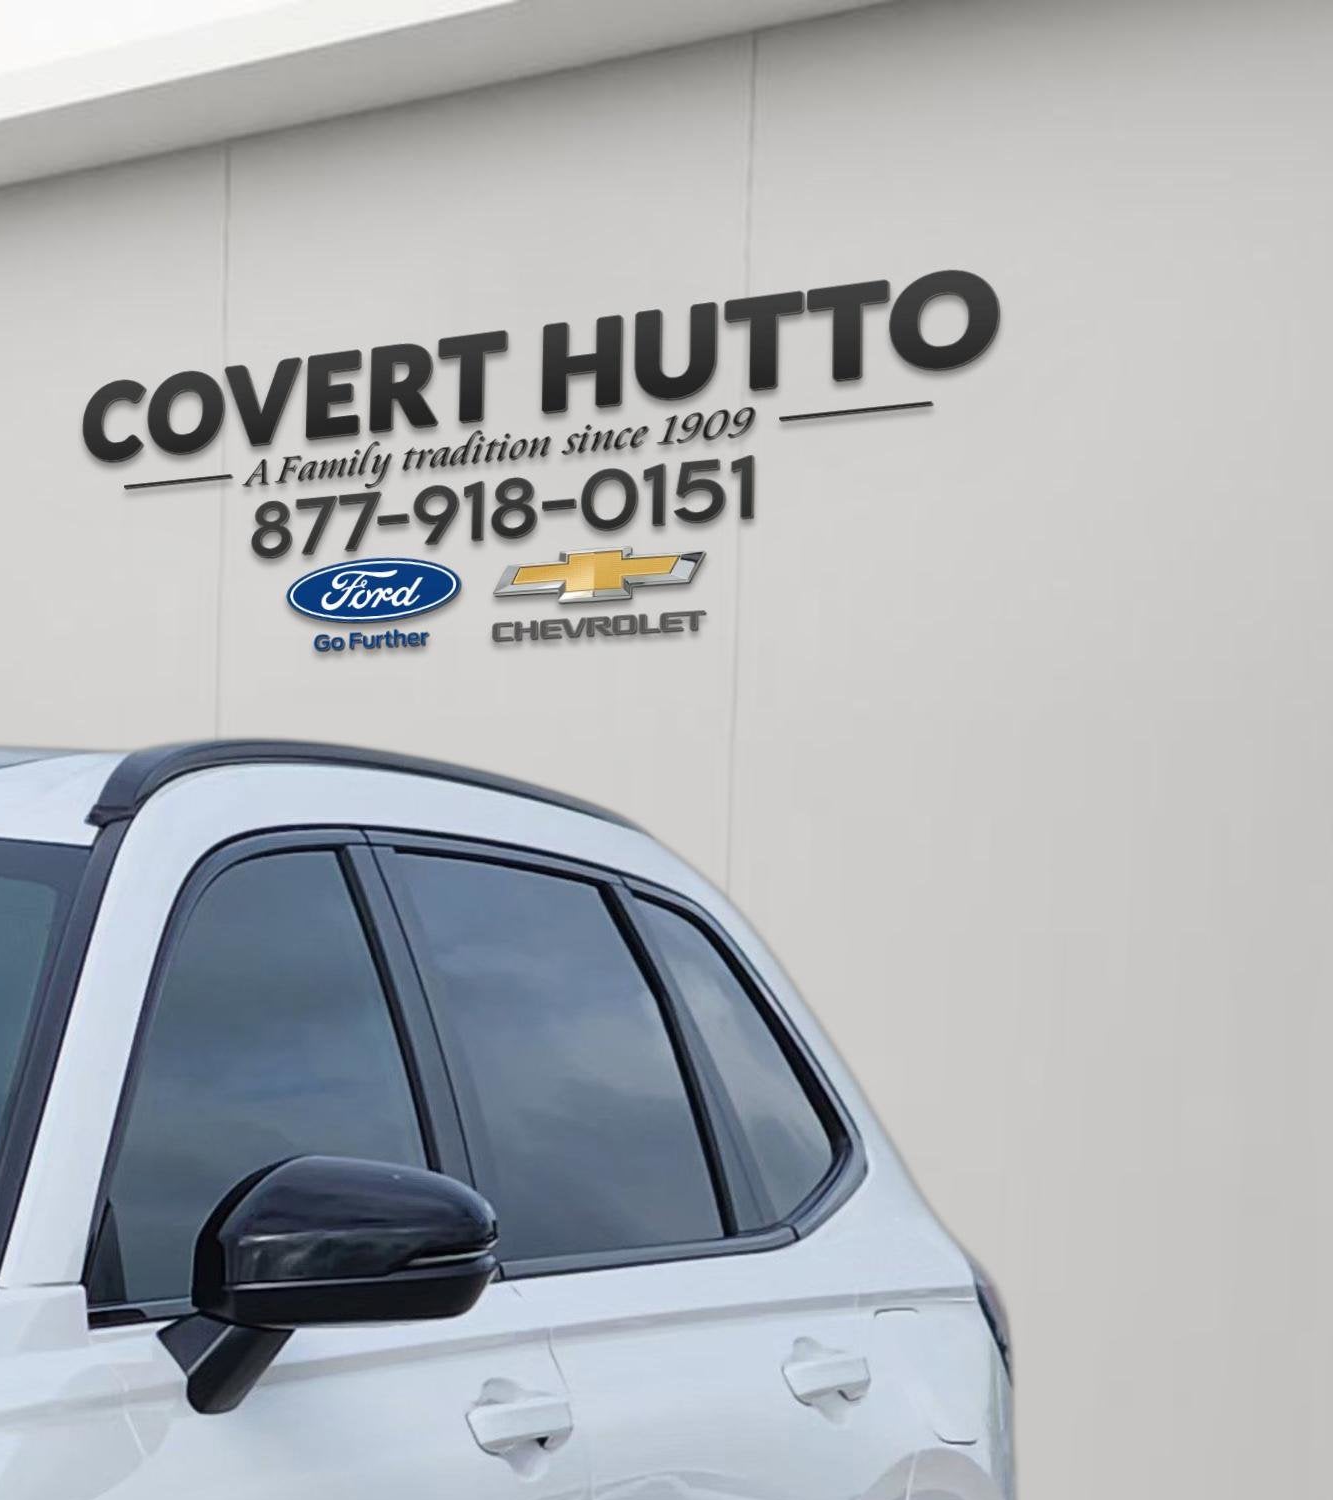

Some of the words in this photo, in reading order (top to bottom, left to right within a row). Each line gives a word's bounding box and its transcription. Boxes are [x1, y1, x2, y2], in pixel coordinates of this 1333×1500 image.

[82, 330, 509, 464] COVERT
[541, 269, 1001, 416] HUTTO
[242, 458, 269, 488] A
[275, 440, 393, 489] Family
[402, 429, 551, 472] tradition
[560, 424, 650, 456] since
[656, 406, 756, 446] 1909
[251, 454, 755, 560] 877-918-0151
[320, 569, 423, 611] Ford
[313, 634, 346, 653] Go
[348, 628, 431, 651] Further
[491, 610, 707, 643] CHEVROLET
